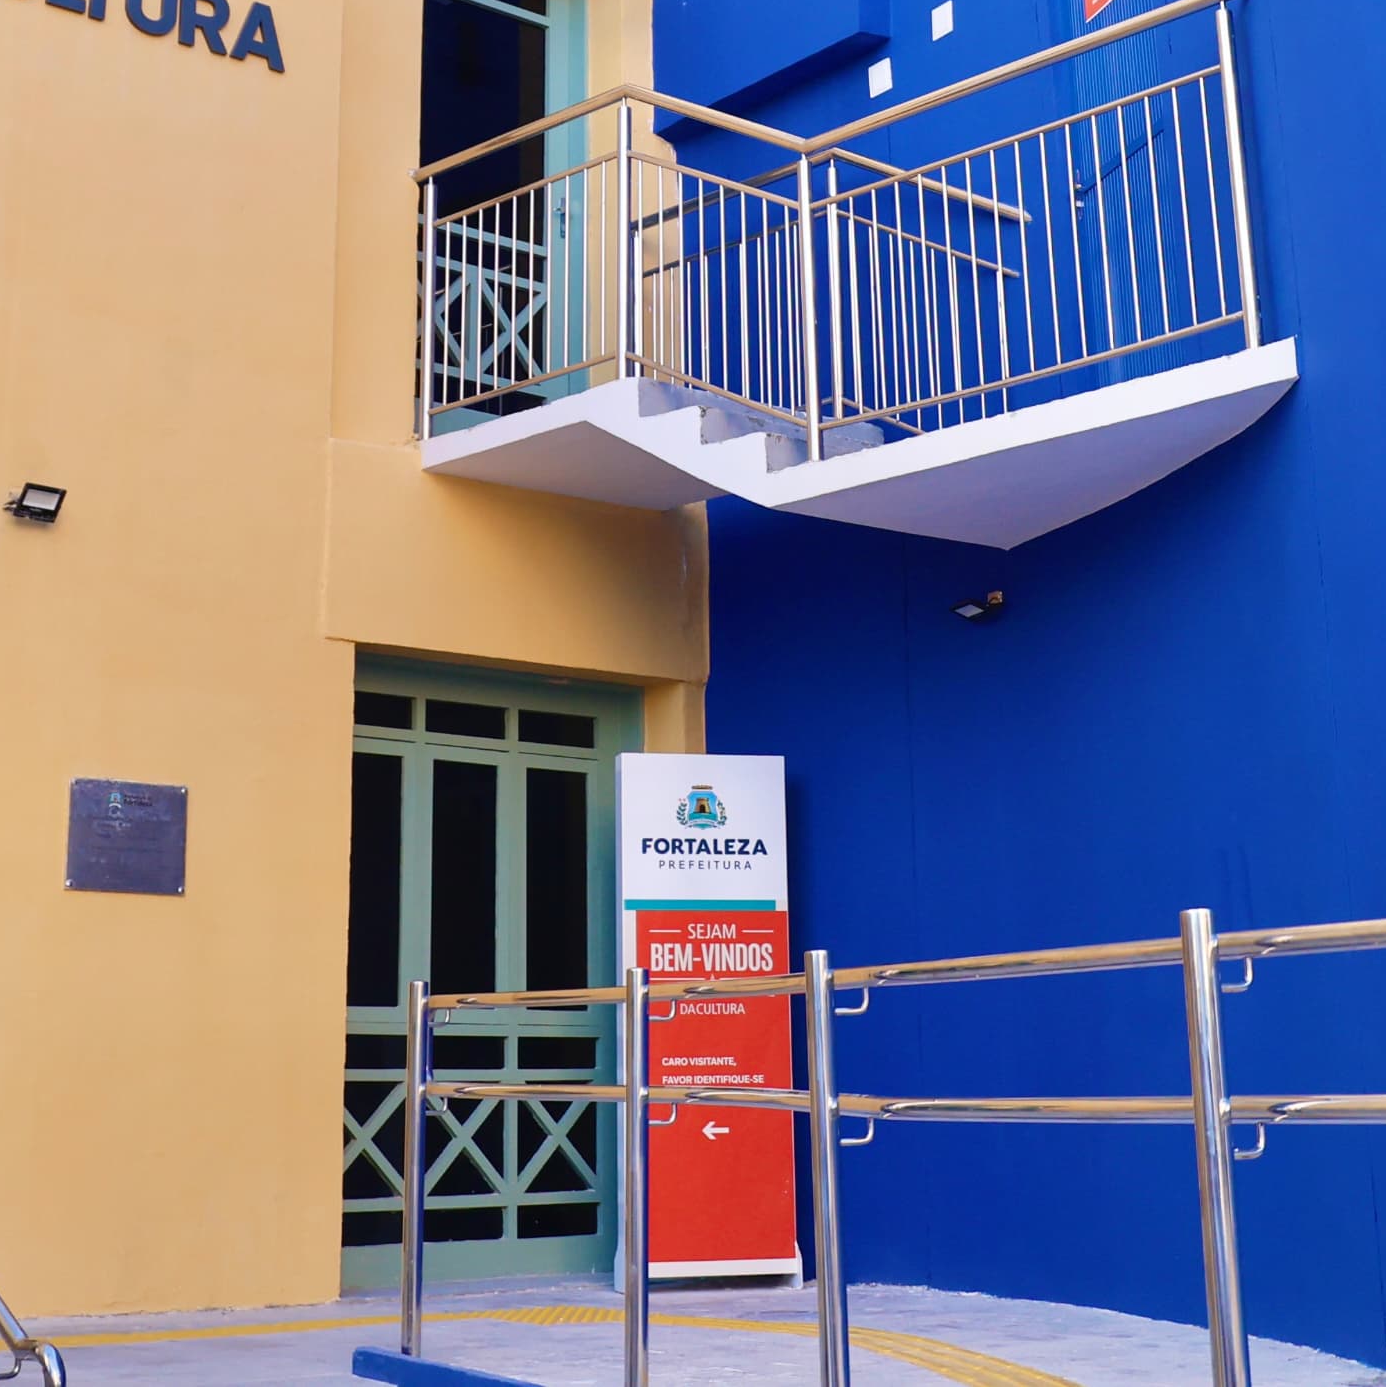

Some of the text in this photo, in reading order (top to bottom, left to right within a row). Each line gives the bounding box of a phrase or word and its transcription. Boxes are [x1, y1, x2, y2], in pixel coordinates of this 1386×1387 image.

[641, 838, 768, 855] FORTALEZA
[658, 860, 752, 870] PREFEITURA
[687, 923, 736, 939] SEJAM
[650, 943, 773, 972] BEM-VINDOS
[662, 1057, 737, 1067] CARO VISITANTE,
[662, 1074, 764, 1085] FAVOR IDENTIFIQUE-SE
